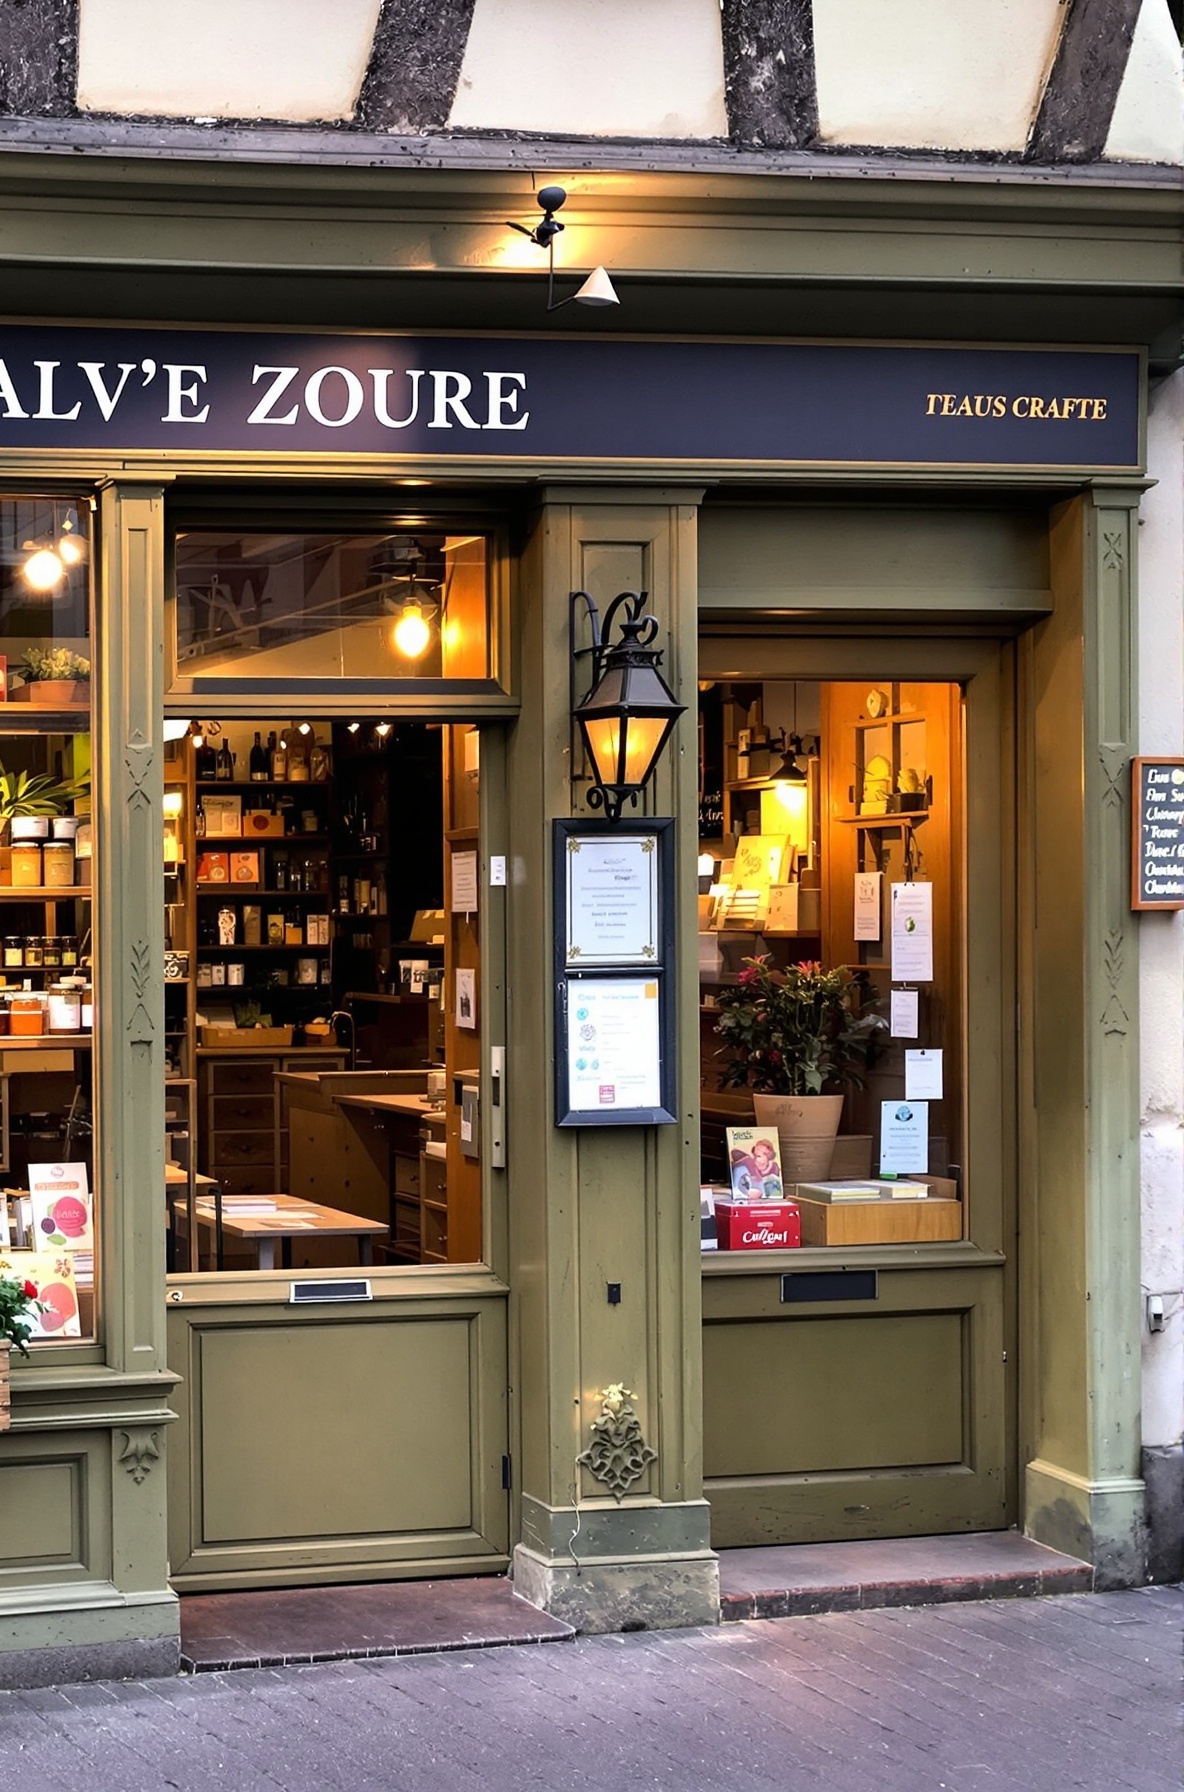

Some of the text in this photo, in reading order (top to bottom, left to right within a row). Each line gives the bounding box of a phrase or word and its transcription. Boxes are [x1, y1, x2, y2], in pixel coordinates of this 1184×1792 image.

[247, 364, 530, 431] ZOURE
[925, 393, 1107, 420] TEAUS CRAFTE
